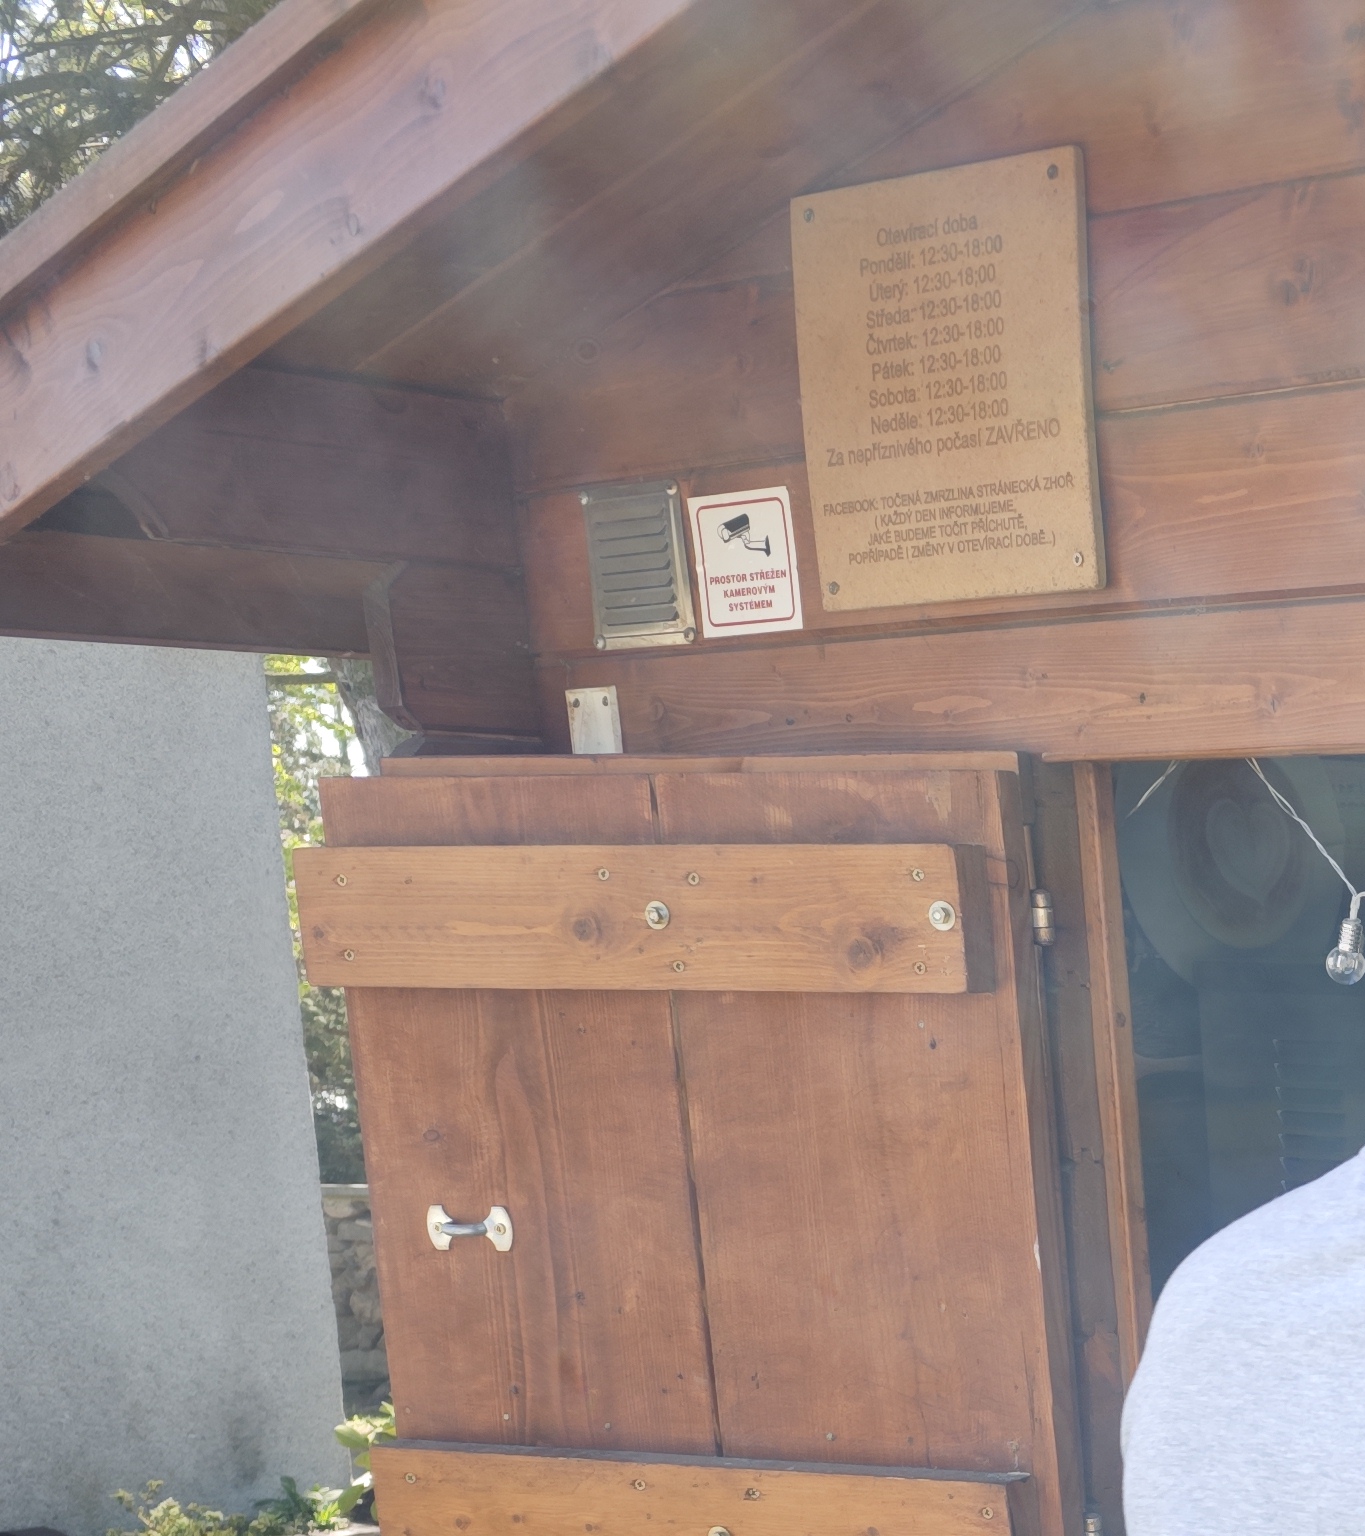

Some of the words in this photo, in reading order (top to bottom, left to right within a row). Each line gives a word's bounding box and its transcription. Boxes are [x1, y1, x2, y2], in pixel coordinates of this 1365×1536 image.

[877, 217, 938, 247] Otevírací
[943, 213, 978, 235] doba
[860, 251, 916, 277] Pondělí:
[920, 234, 1003, 267] 12:30-18:00
[869, 279, 909, 302] Úterý:
[866, 307, 914, 329] Středa:
[919, 290, 1002, 320] 12:30-18:00
[866, 332, 917, 356] Čtvrtek:
[923, 316, 1005, 347] 12:30-18:00
[872, 358, 915, 382] Pátek:
[920, 344, 1001, 374] 12:30-18:00
[869, 386, 921, 409] Sobota:
[926, 371, 1008, 400] 12:30-18:00
[871, 412, 923, 435] Neděle:
[927, 398, 1009, 427] 12:30-18:00
[827, 448, 844, 467] Za
[848, 437, 933, 467] nepříznivého
[937, 431, 982, 456] počasí
[986, 418, 1061, 446] ZAVŘENO
[880, 489, 921, 509] TOČENÁ
[924, 485, 975, 505] ZMRZLINA
[977, 475, 1042, 498] STRÁNECKÁ
[1043, 471, 1075, 490] ZHOŘ
[915, 508, 936, 523] DEN
[938, 500, 1017, 520] INFORMUJEME,
[868, 528, 892, 546] JAKÉ
[894, 526, 936, 543] BUDEME
[938, 520, 968, 537] TOČIT
[912, 538, 945, 559] ZMĚNY
[948, 540, 954, 554] V
[957, 534, 1013, 554] OTEVÍRACÍ
[709, 573, 748, 585] PROSTOR
[749, 568, 787, 582] STŘEŽEN
[723, 583, 776, 598] KAMEROVÝM
[728, 599, 773, 612] SYSTÉMEM
